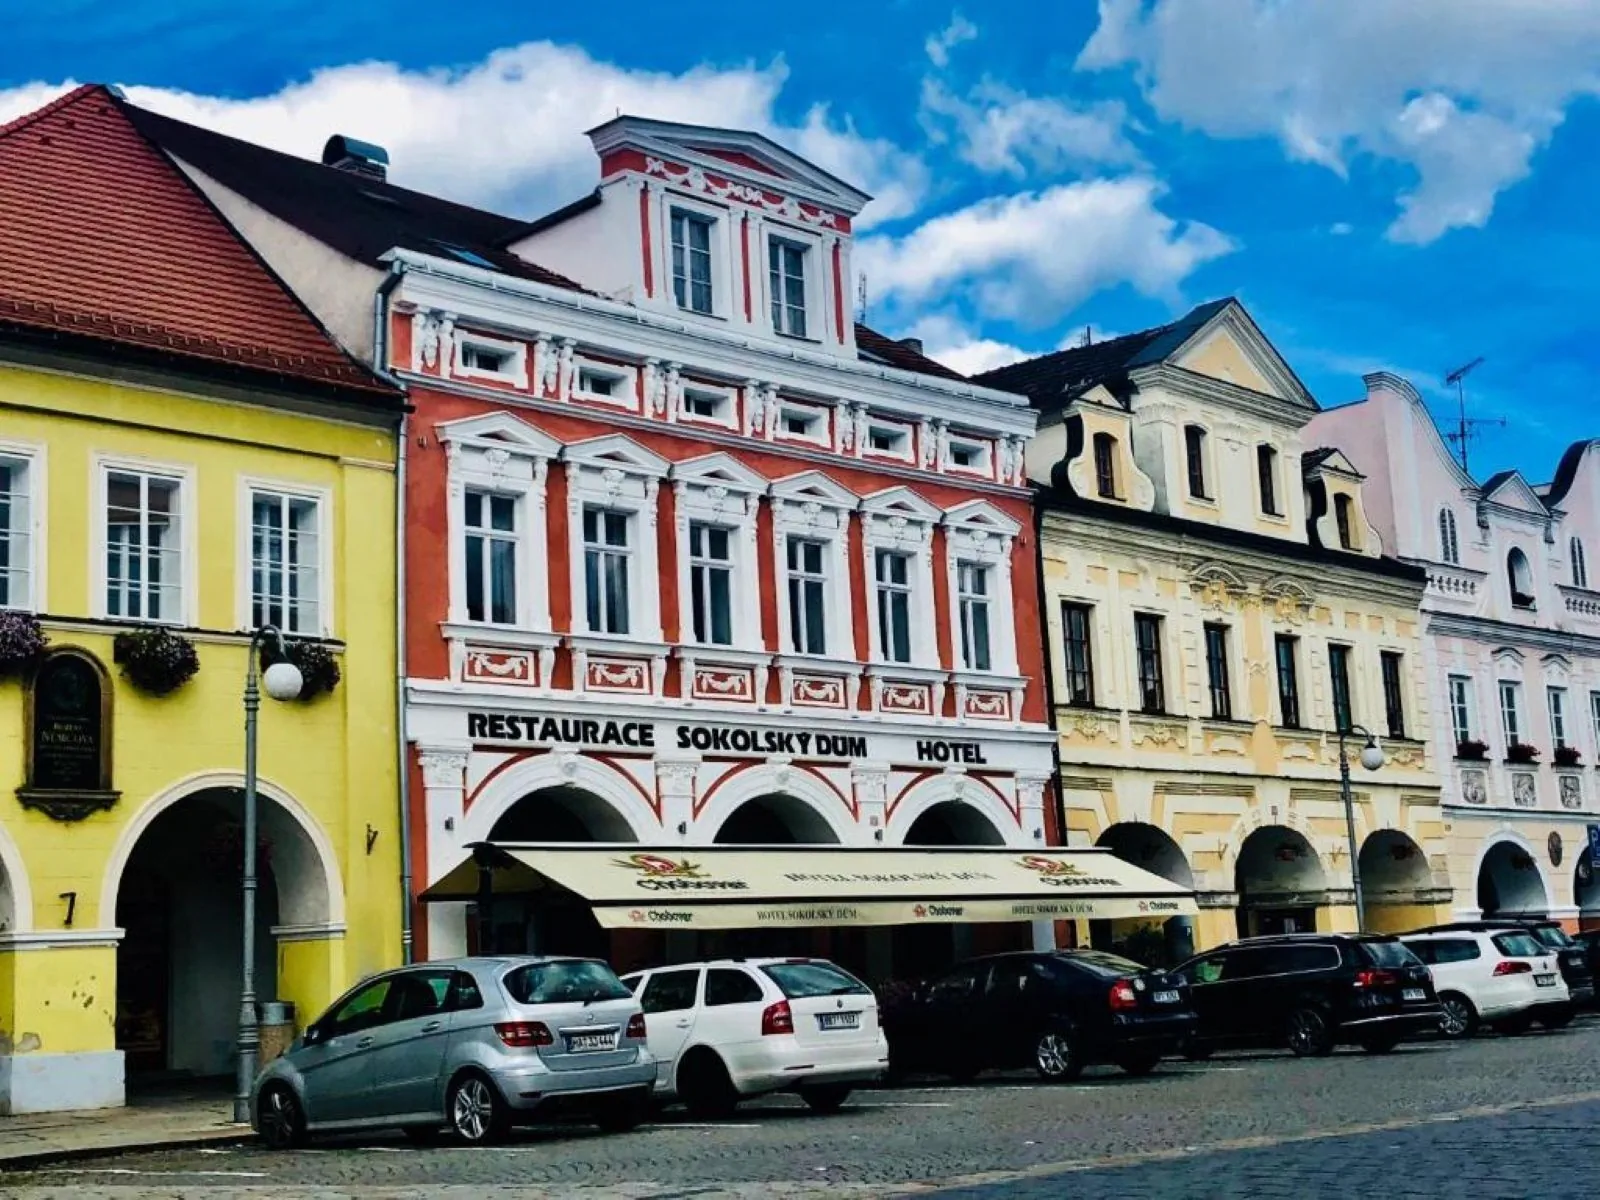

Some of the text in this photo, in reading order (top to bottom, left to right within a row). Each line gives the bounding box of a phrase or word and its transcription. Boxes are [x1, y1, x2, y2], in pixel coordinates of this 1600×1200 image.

[467, 712, 655, 747] RESTAURACE
[917, 740, 987, 764] HOTEL
[59, 892, 77, 926] 7
